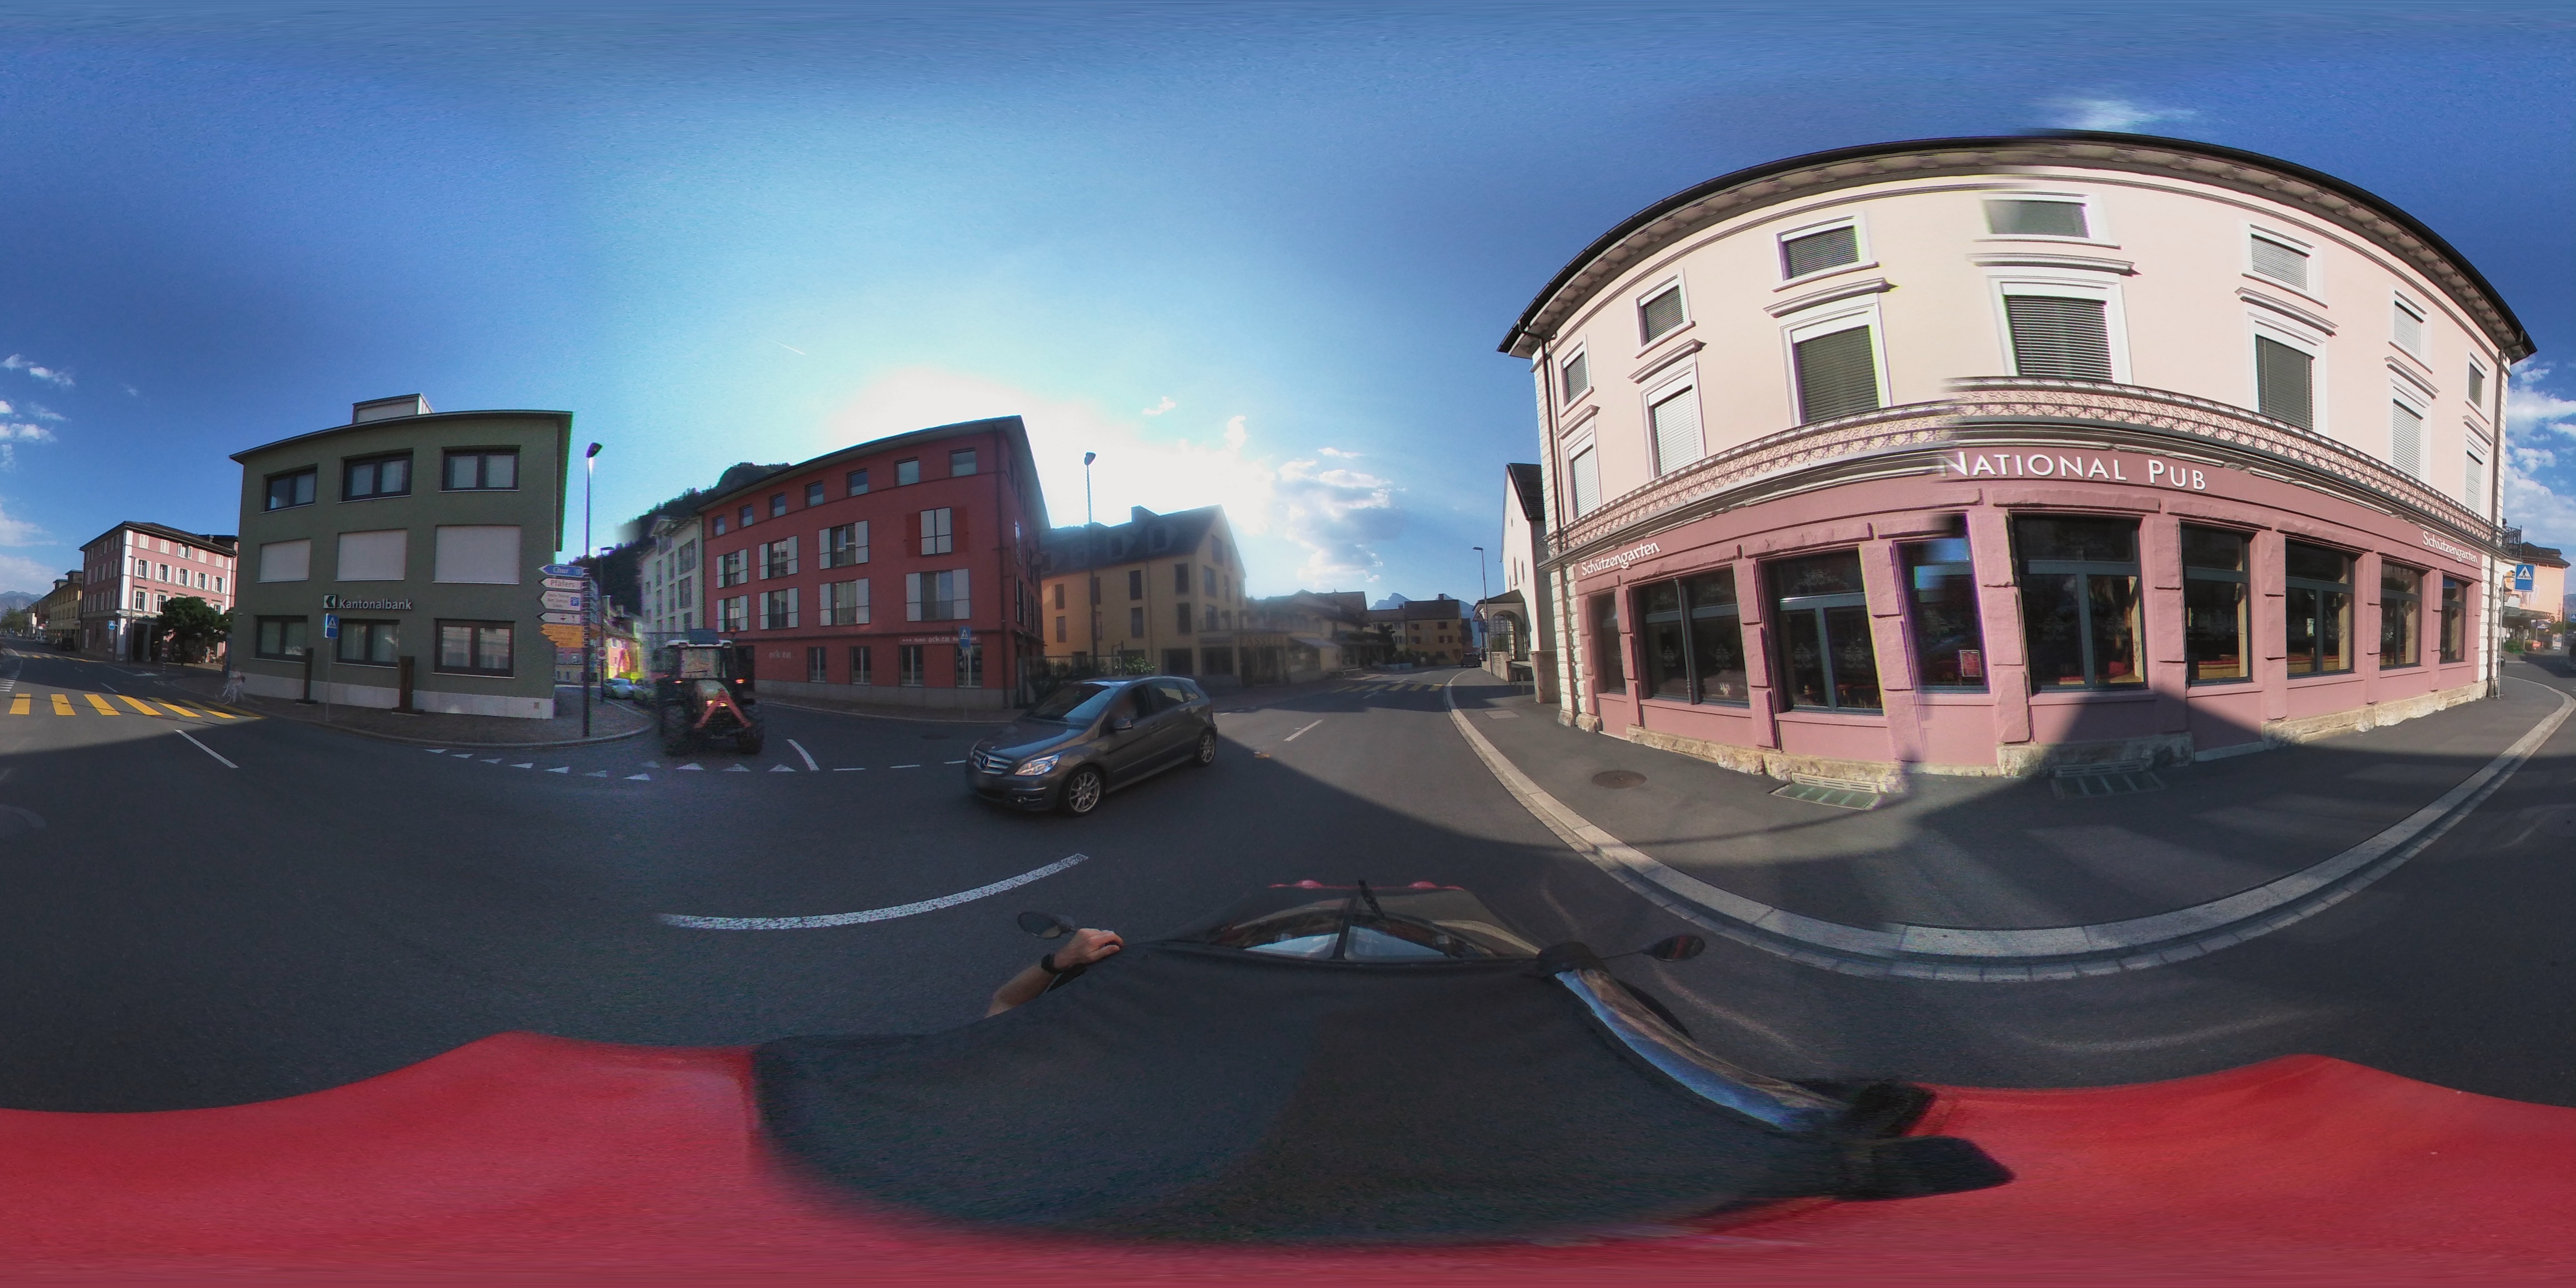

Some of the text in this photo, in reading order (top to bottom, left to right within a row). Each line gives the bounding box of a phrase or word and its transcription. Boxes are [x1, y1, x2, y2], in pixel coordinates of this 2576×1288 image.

[1941, 450, 2206, 490] NATIONAL PUB
[1581, 542, 1661, 576] Schützengarten
[2423, 531, 2478, 563] Schützengarten
[550, 579, 575, 588] Pfäfers
[339, 598, 412, 610] Kantonalbank
